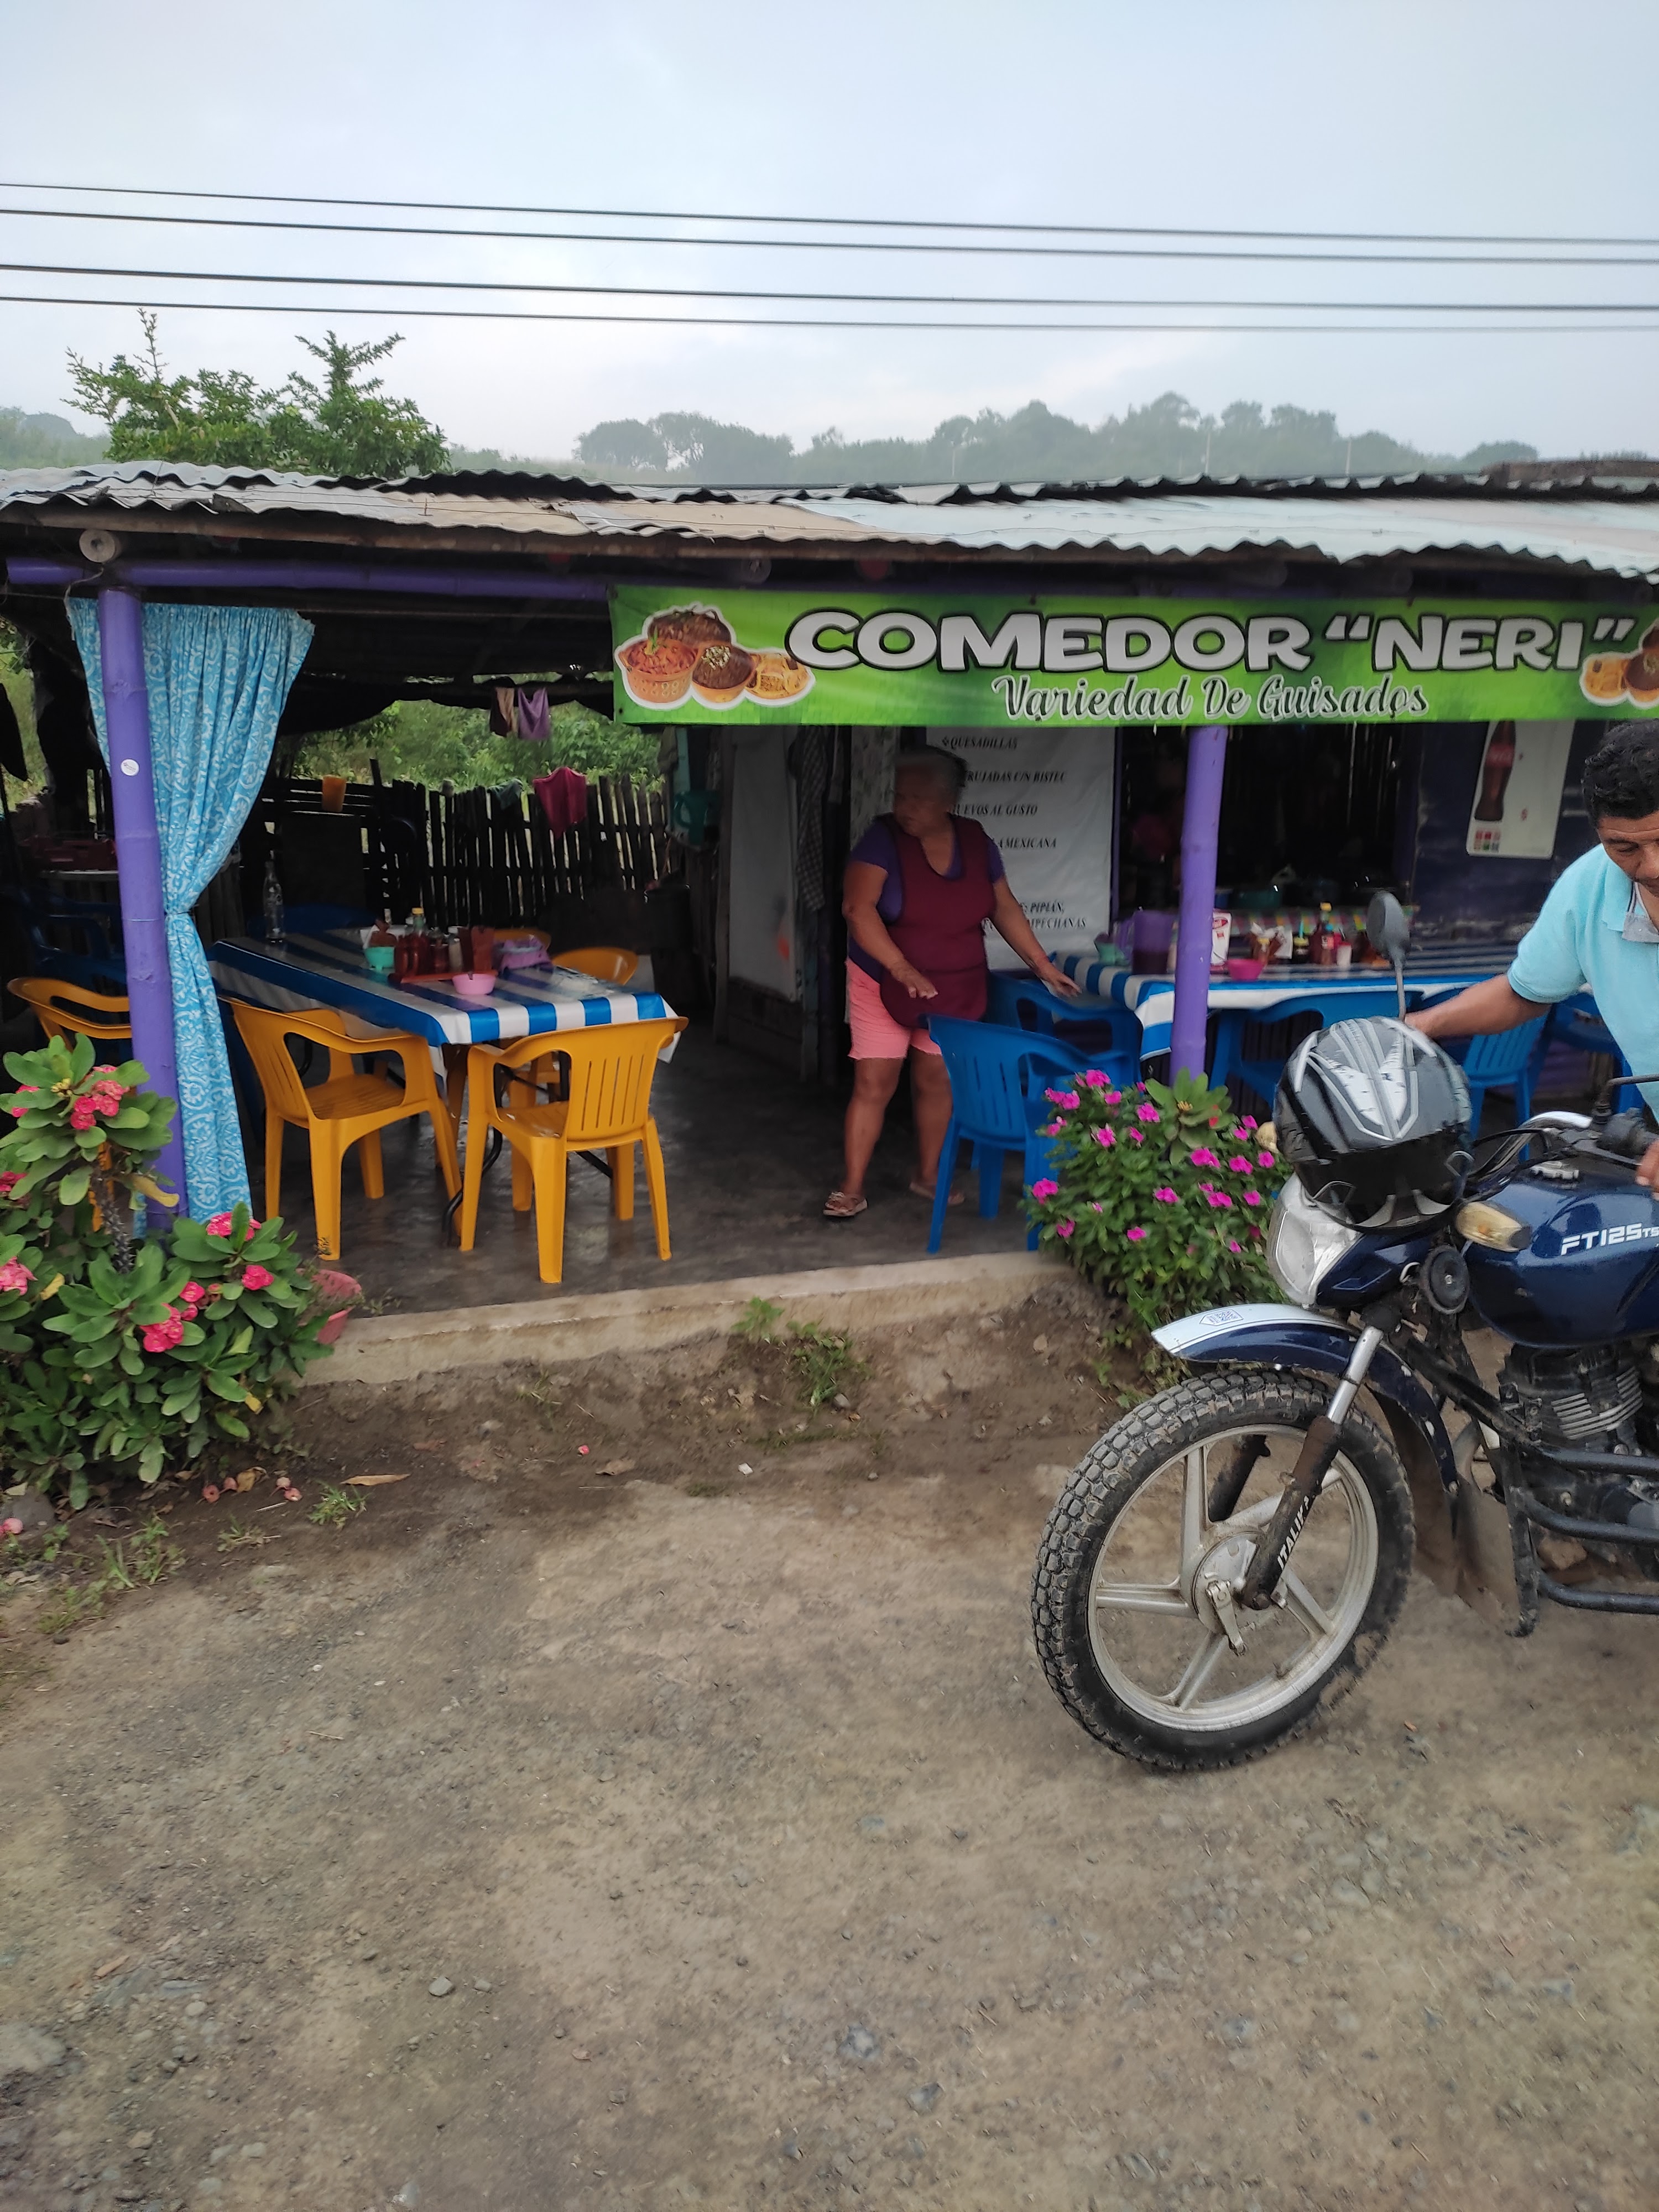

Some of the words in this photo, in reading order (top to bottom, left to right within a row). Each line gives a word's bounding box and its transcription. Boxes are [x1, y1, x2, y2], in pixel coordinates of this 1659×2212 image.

[787, 610, 1313, 671] COMEDOR
[992, 675, 1192, 720] Variedad
[1201, 675, 1251, 718] De
[1257, 674, 1430, 721] Guisados
[950, 736, 1018, 750] QUESADILLAS
[1005, 804, 1038, 817] GUSTO
